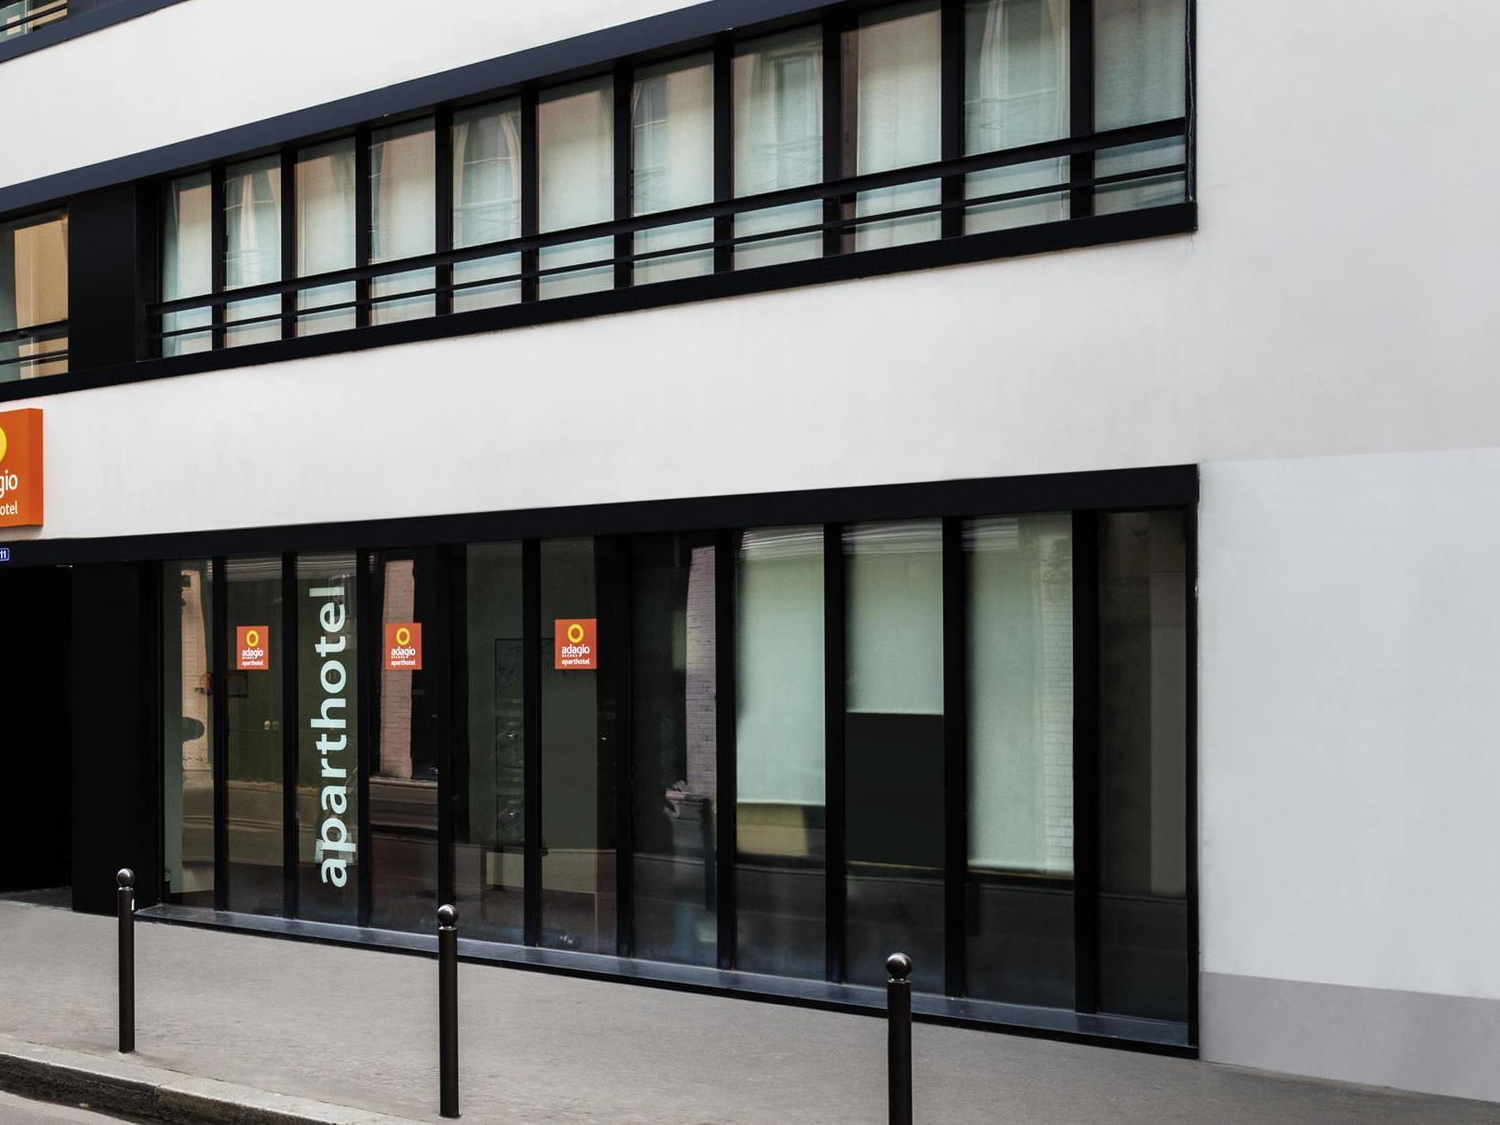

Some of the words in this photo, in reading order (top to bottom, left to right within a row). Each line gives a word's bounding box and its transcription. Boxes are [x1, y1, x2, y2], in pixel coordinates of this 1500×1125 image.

[0, 550, 7, 559] 11
[241, 647, 264, 659] adagio
[390, 646, 416, 659] adagio
[561, 644, 590, 658] adagio
[561, 658, 590, 667] aparthotel
[309, 586, 357, 888] aparthotel
